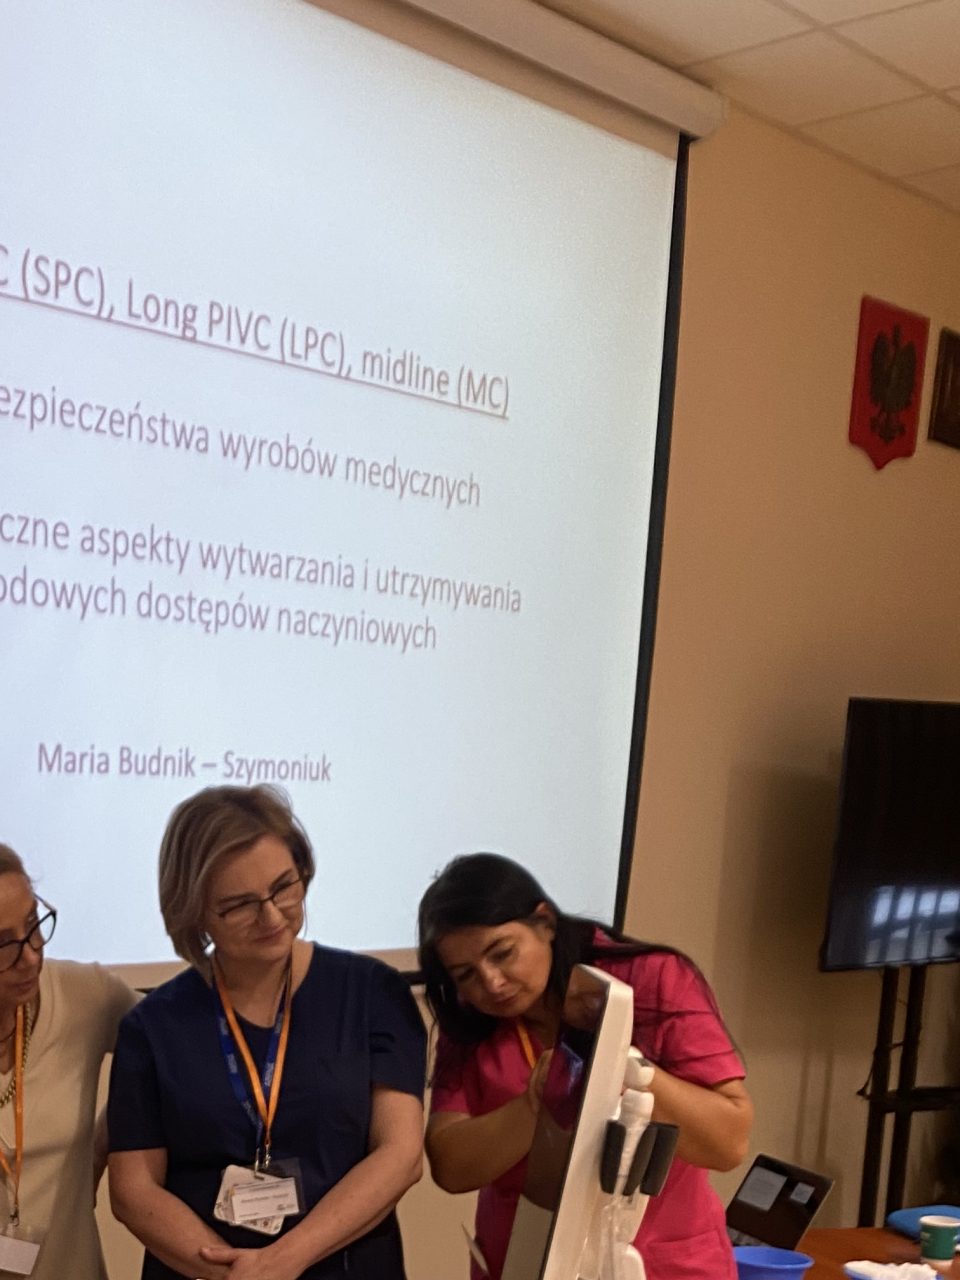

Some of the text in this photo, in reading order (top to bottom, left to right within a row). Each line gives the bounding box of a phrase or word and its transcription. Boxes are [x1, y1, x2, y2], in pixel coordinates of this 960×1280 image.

[22, 247, 114, 320] (SPC),
[127, 278, 198, 341] Long
[208, 301, 272, 352] PIVC
[279, 317, 351, 379] (LPC),
[362, 350, 450, 396] midline
[457, 366, 509, 417] (MC)
[220, 431, 338, 479] wyrobów
[345, 457, 481, 510] medycznych
[79, 523, 190, 575] aspekty
[199, 542, 355, 589] wytwarzania
[363, 567, 368, 592] i
[376, 566, 521, 614] utrzymywania
[136, 581, 270, 636] dostępów
[277, 608, 437, 653] naczyniowych
[37, 742, 110, 775] Maria
[119, 745, 196, 780] Budnik
[223, 751, 332, 785] Szymoniuk
